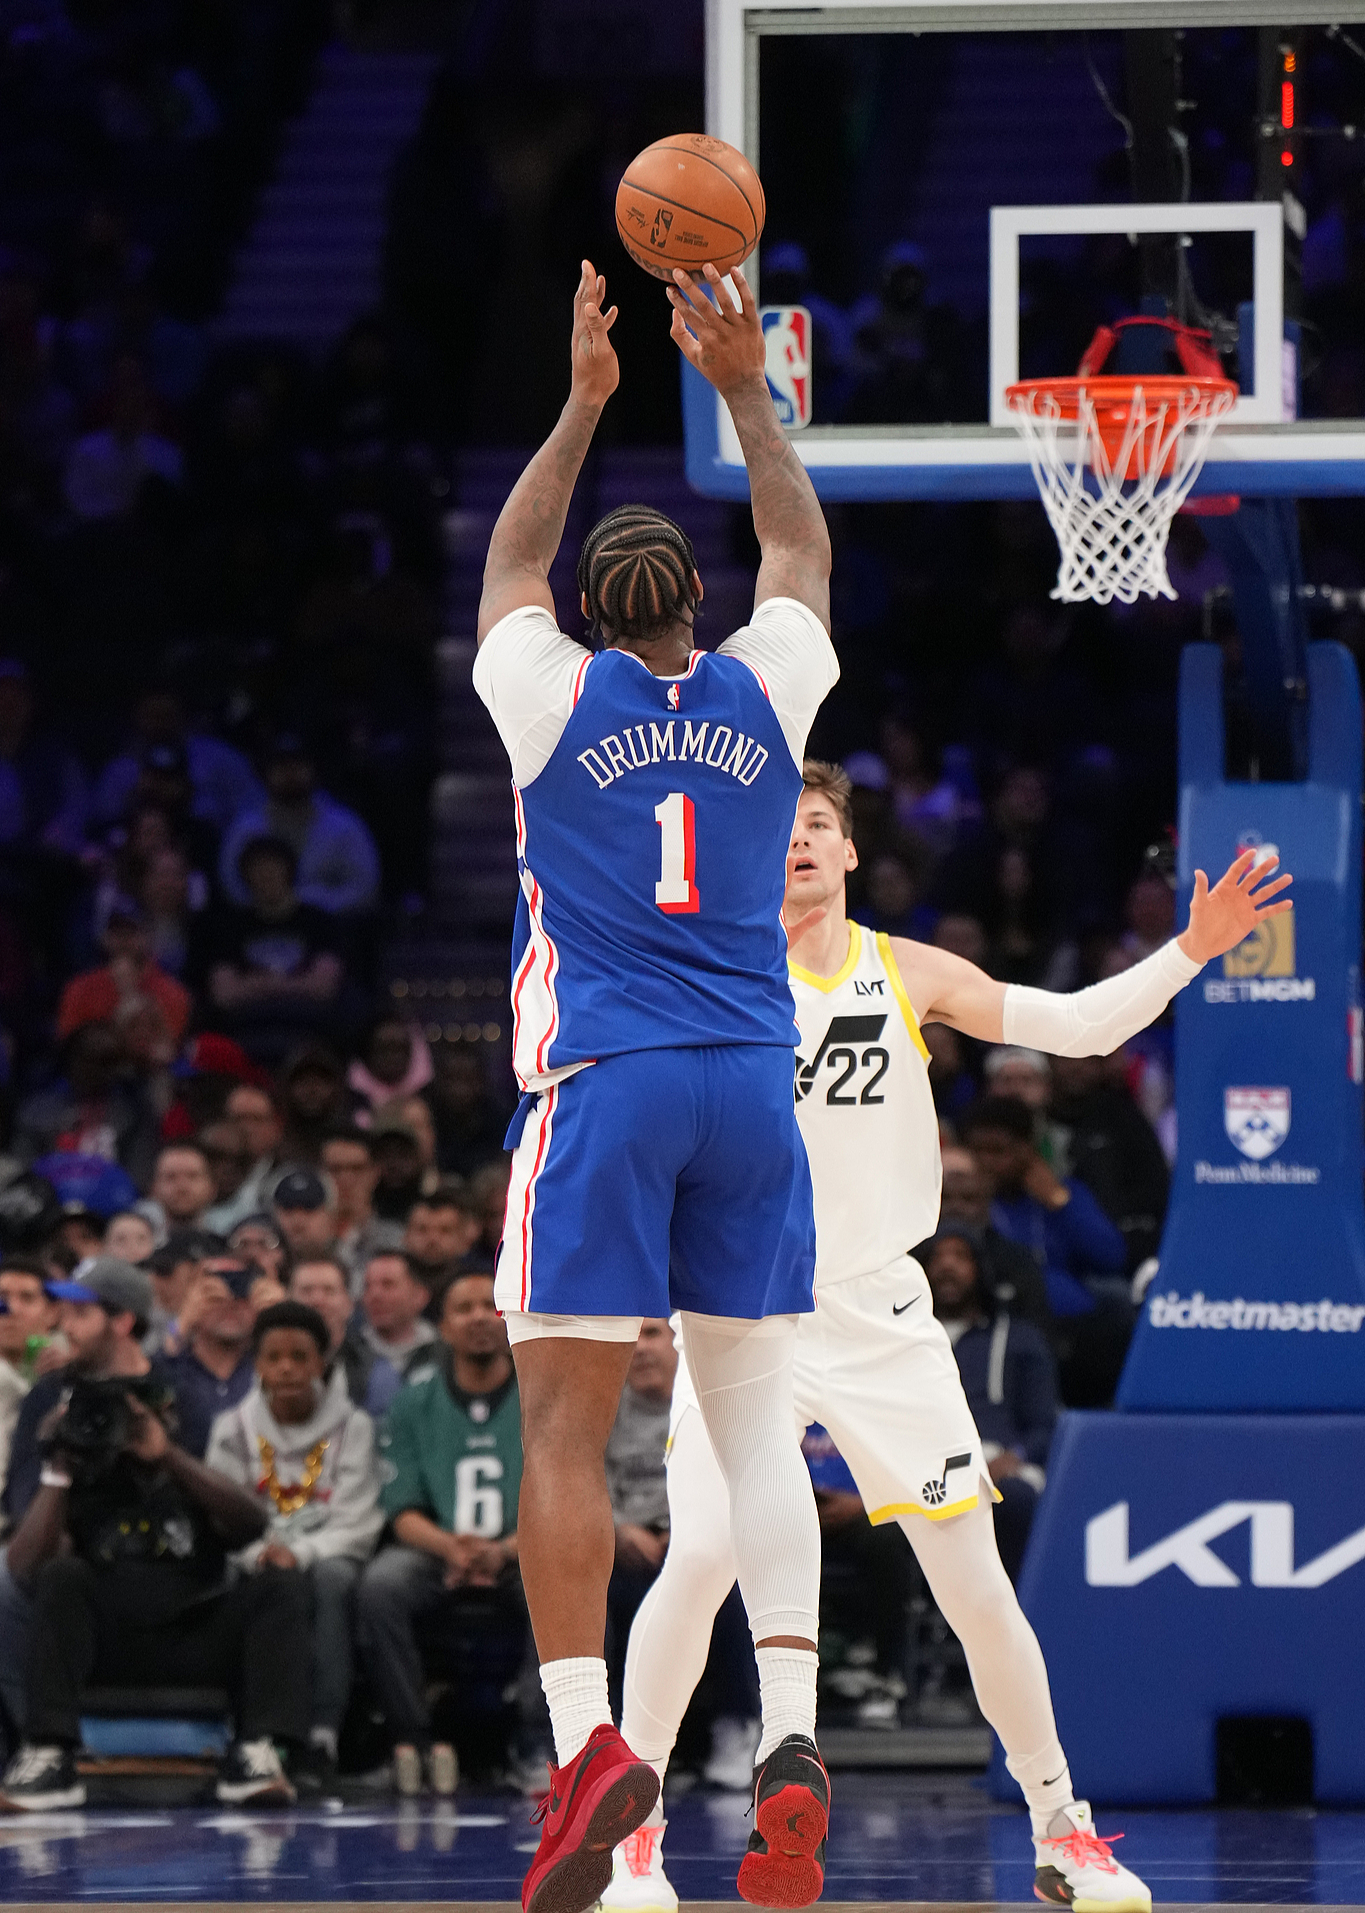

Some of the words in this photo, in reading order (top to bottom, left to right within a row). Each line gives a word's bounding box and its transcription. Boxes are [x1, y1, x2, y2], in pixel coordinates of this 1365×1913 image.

[577, 720, 769, 789] DRUMMOND
[654, 792, 700, 914] 1
[854, 979, 885, 996] LVT
[1204, 978, 1315, 1003] BETMGM
[826, 1047, 890, 1106] 22
[1194, 1160, 1240, 1184] Penn
[1239, 1160, 1320, 1184] Medicine
[1150, 1291, 1365, 1333] ticketmaster
[455, 1455, 504, 1539] 6
